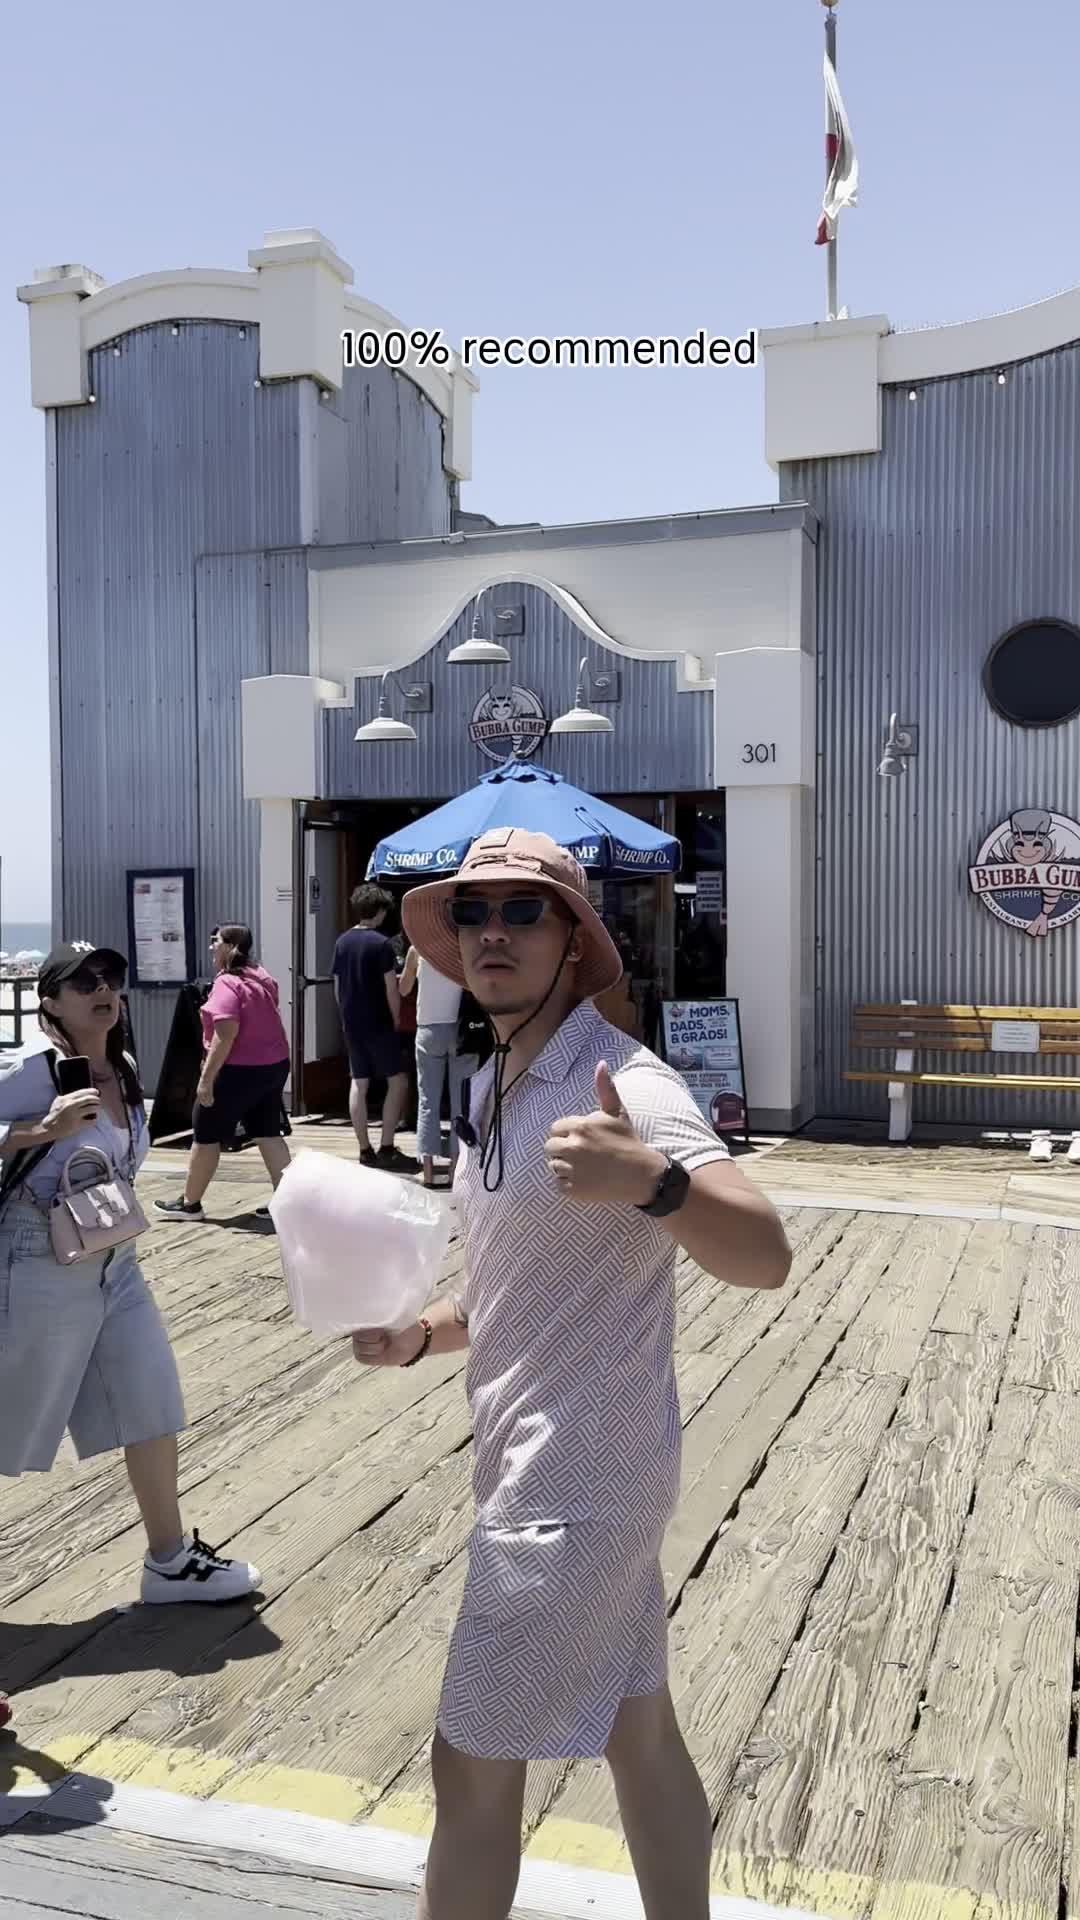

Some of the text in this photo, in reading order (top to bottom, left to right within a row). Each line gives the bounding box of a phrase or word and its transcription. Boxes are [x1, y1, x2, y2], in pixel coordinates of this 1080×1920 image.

[472, 721, 509, 739] BUBBA
[512, 719, 545, 735] GUMP
[741, 743, 776, 763] 301
[384, 851, 433, 868] SHRIMP
[615, 845, 653, 864] SHRIMP
[975, 867, 1040, 889] BUBBA
[994, 889, 1041, 900] SHRIMP
[689, 1005, 730, 1018] MOMS,
[681, 1028, 728, 1043] GRADS!
